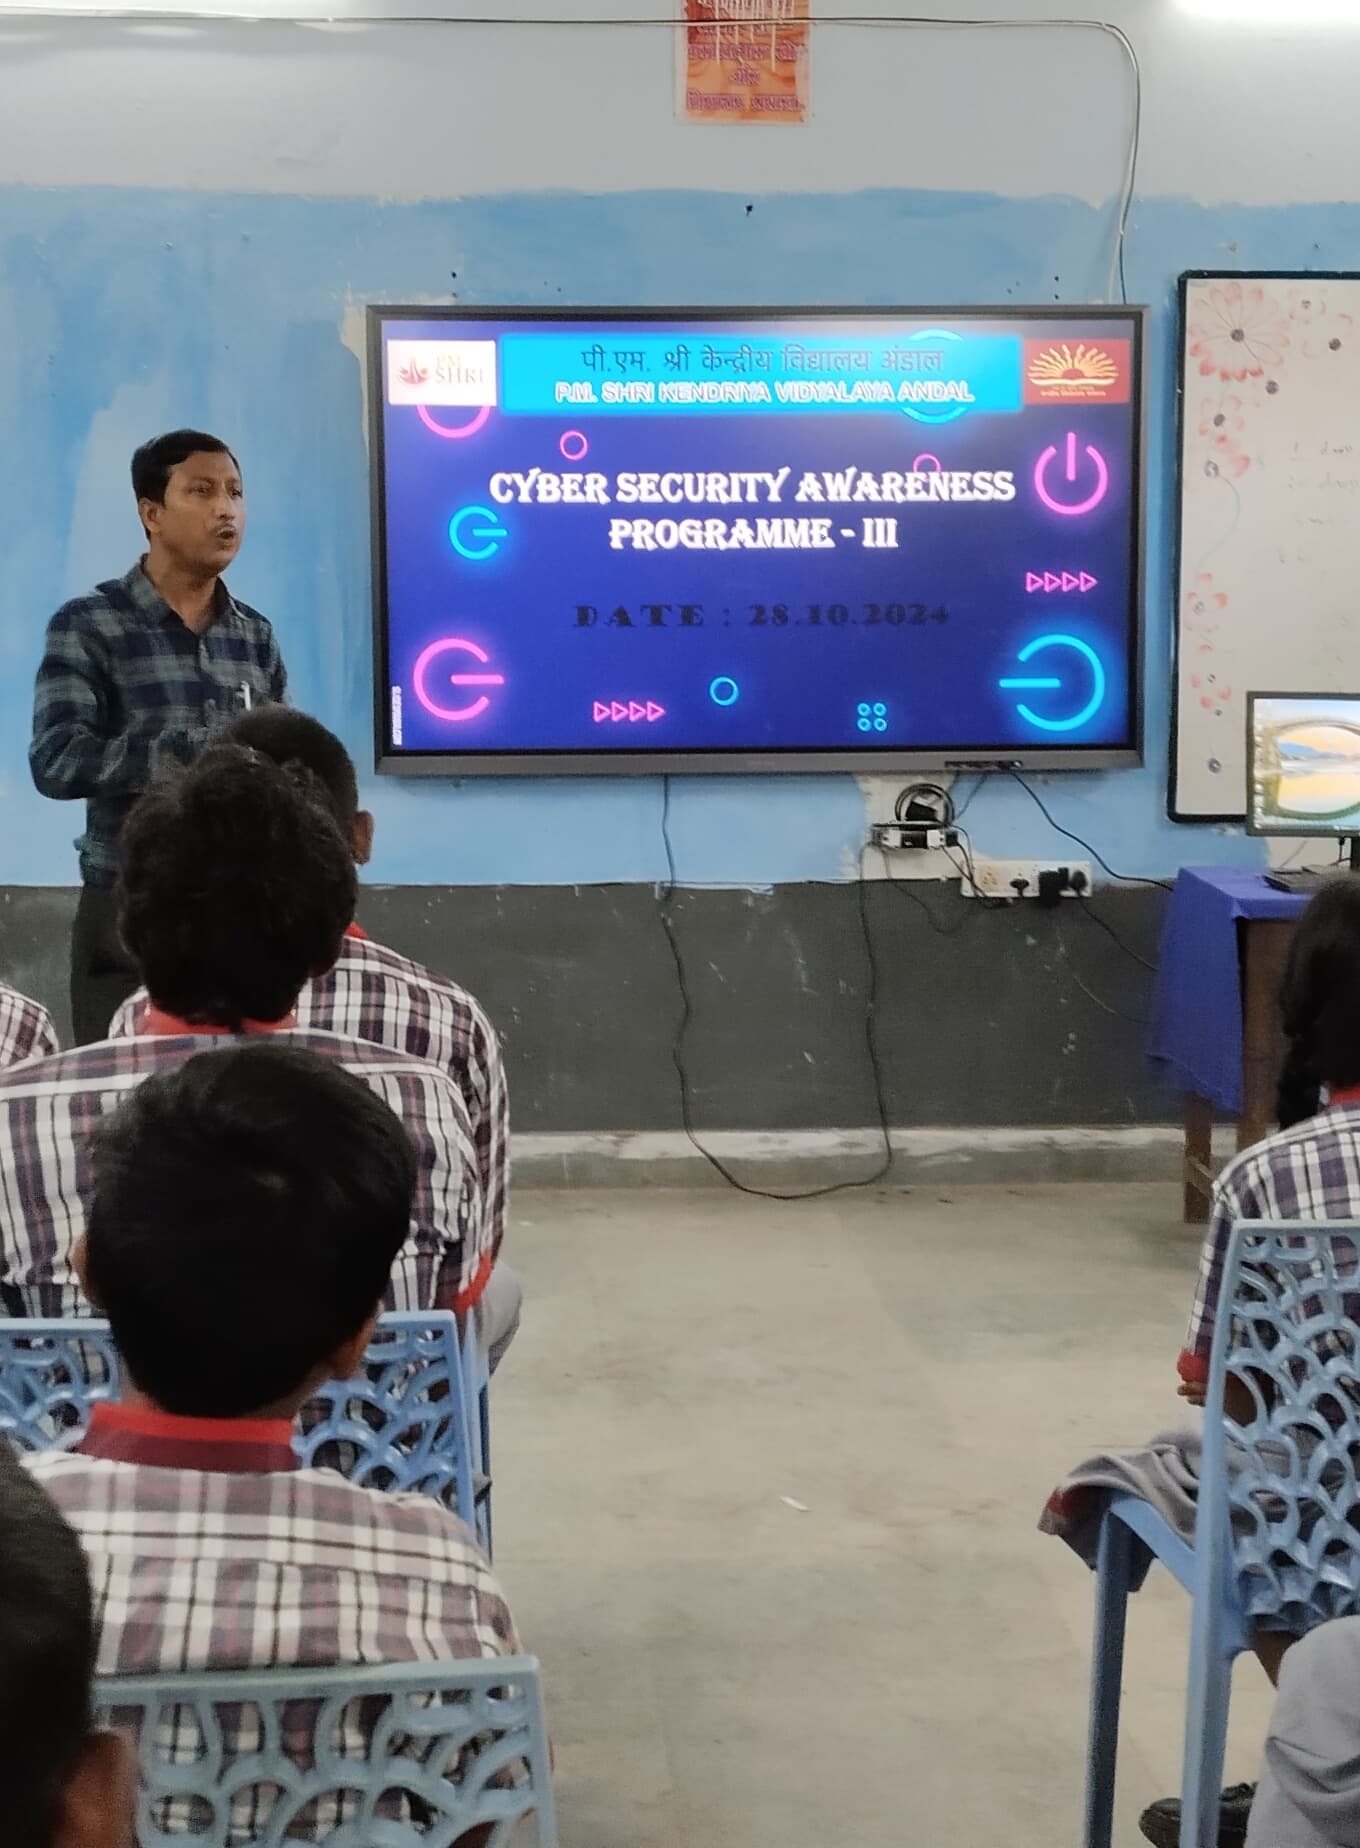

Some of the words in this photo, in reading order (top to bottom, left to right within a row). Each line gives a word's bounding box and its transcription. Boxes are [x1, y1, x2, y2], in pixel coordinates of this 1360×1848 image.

[663, 344, 691, 373] श्री
[435, 367, 484, 385] SHRI
[555, 381, 599, 404] P.M.
[601, 381, 658, 403] SHRI
[658, 381, 771, 403] KENDRIYA
[774, 380, 893, 403] VIDYALAYA
[895, 380, 976, 403] ANDAL
[489, 467, 611, 505] CYBER
[616, 466, 792, 504] SECURITY
[794, 466, 1016, 503] AWARENESS
[608, 517, 836, 551] PROGRAMME
[862, 517, 899, 548] III
[572, 604, 705, 628] DATE
[748, 603, 951, 628] 28.10.2024
